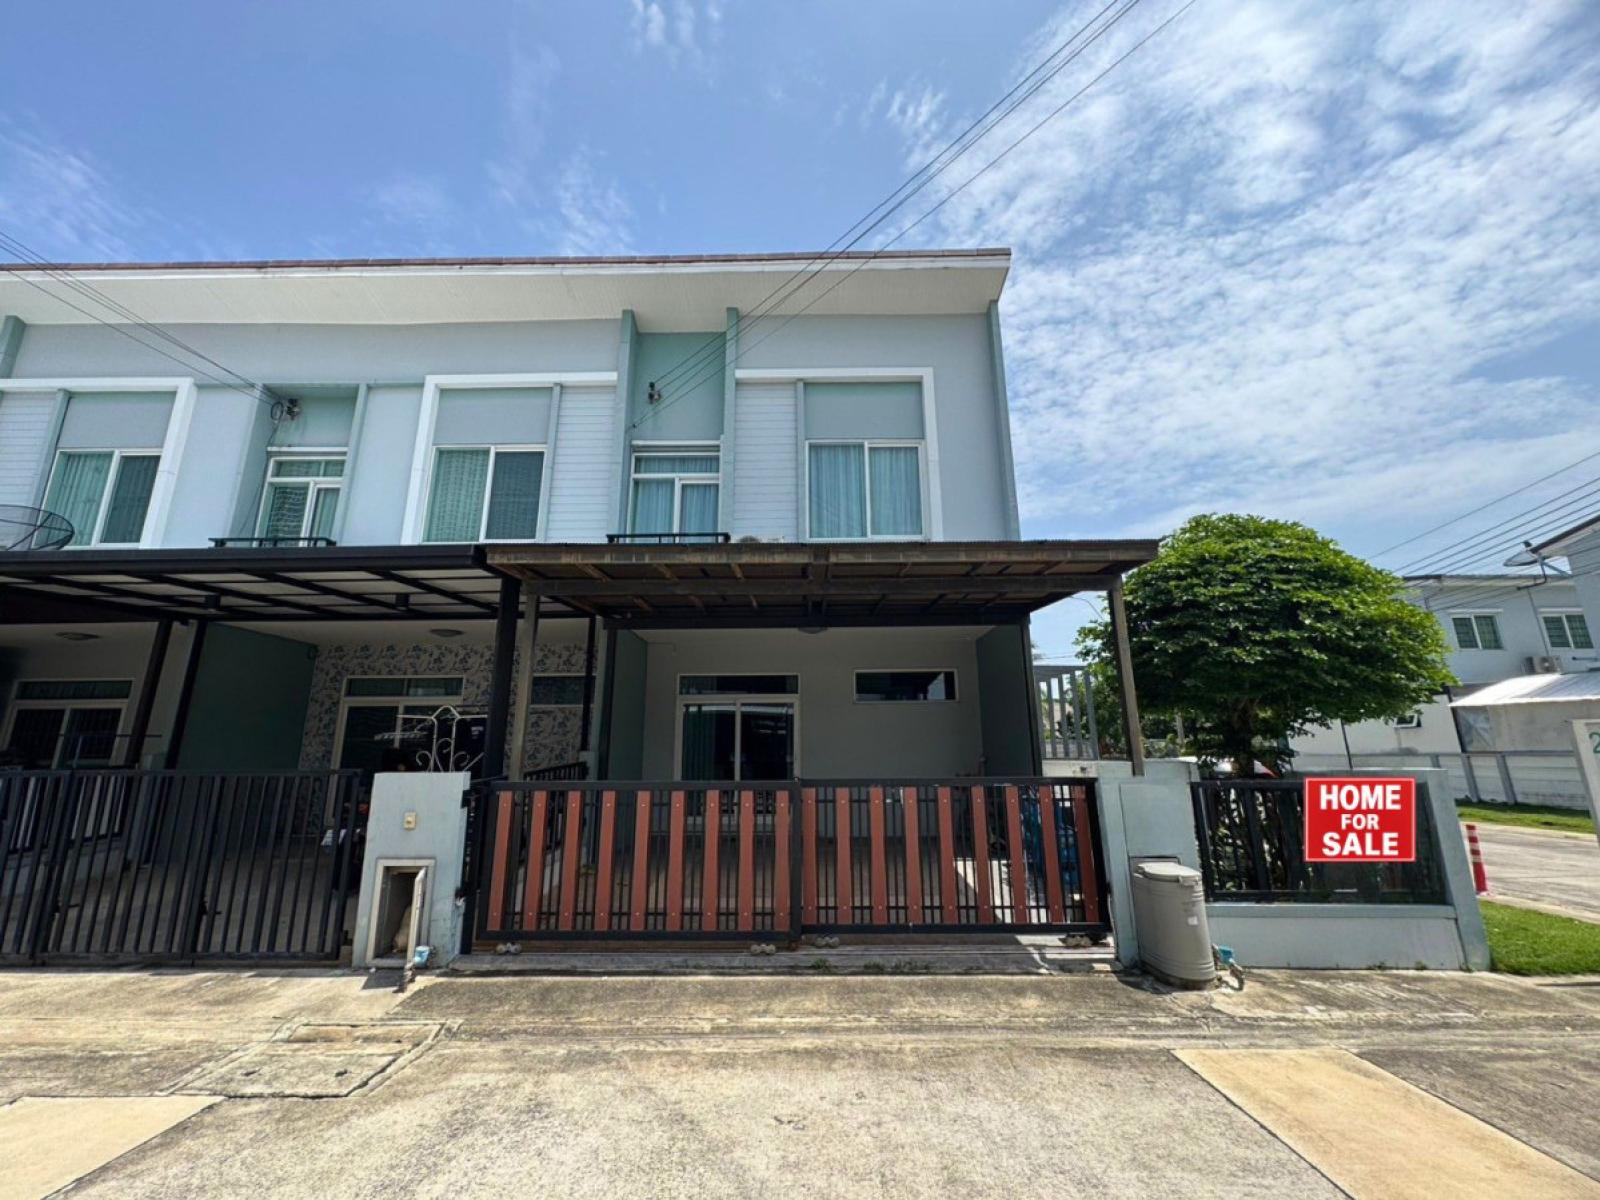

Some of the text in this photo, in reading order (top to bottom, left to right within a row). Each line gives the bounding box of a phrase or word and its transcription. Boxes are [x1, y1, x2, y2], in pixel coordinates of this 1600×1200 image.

[1320, 784, 1402, 810] HOME
[1341, 813, 1380, 830] FOR
[1322, 832, 1399, 857] SALE
